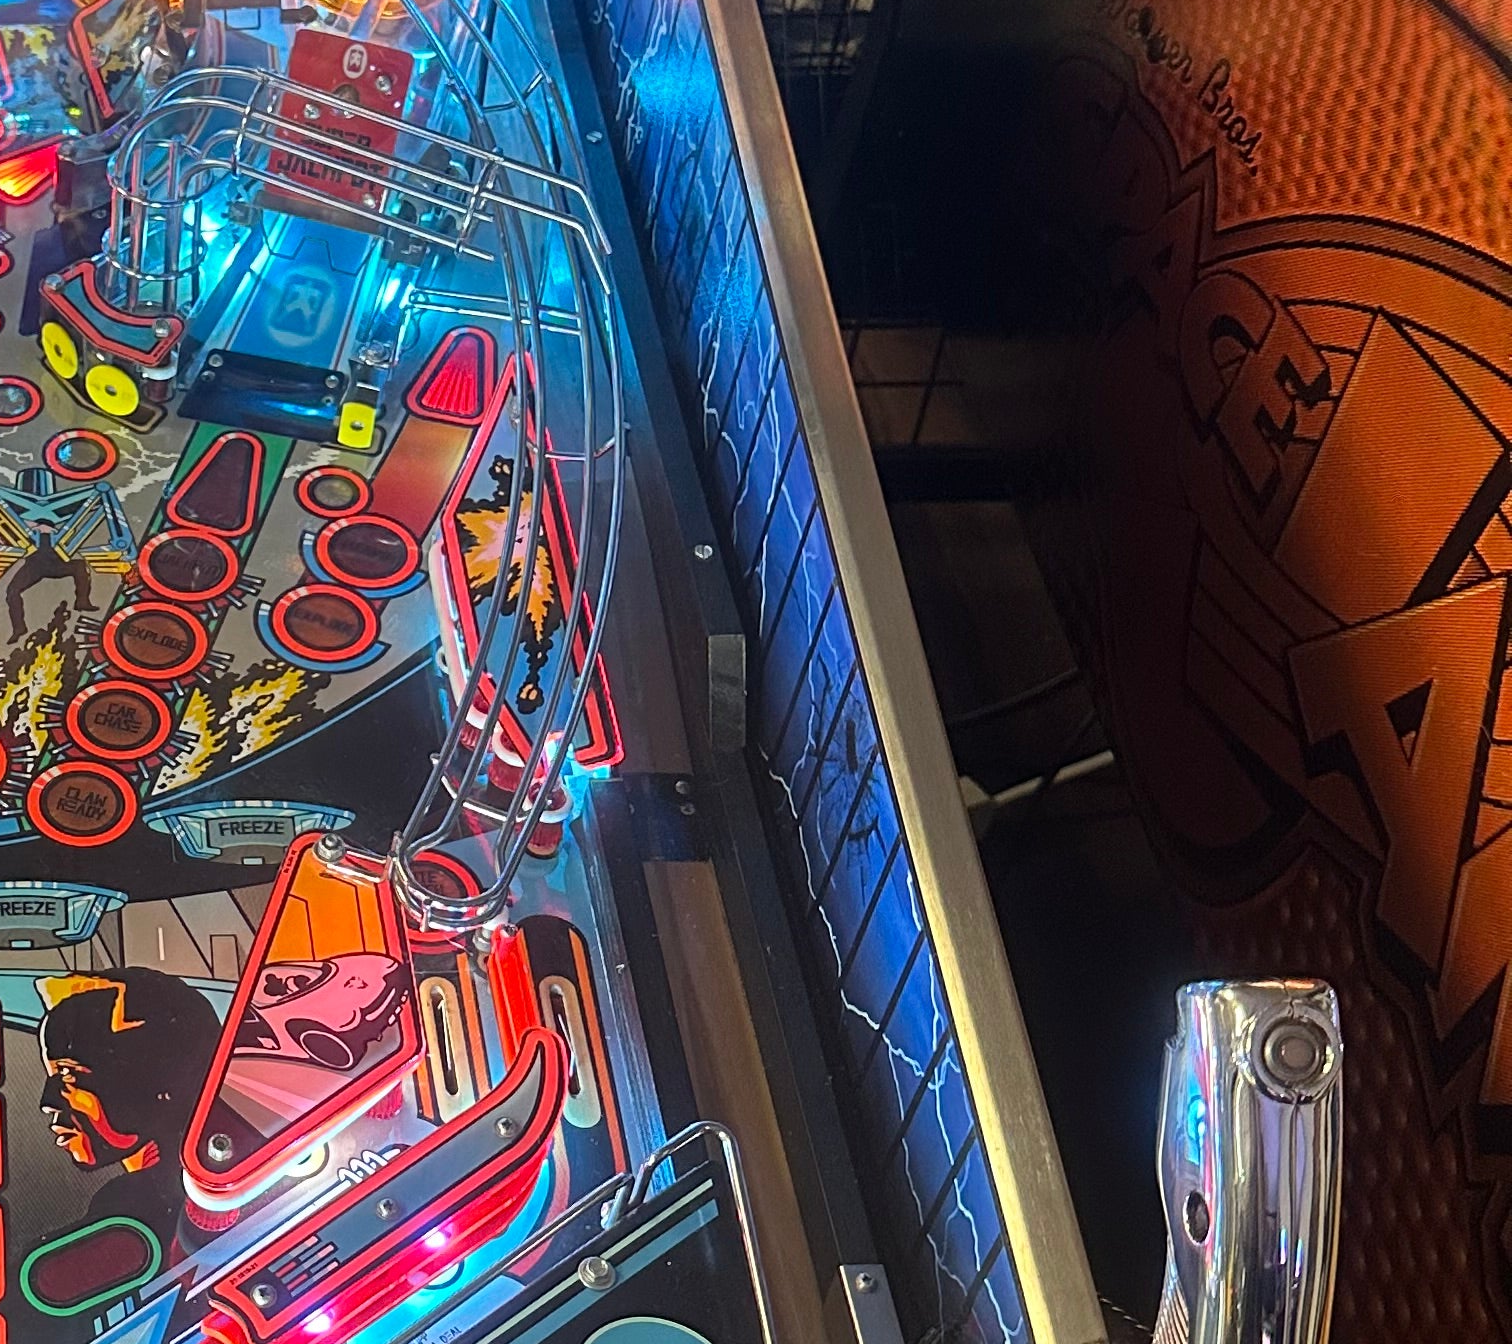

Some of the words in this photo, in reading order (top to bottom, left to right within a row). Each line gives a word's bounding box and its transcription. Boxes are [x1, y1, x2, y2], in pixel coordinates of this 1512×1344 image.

[126, 624, 189, 655] EXPLODE
[105, 701, 137, 719] CAR
[93, 712, 143, 734] CHASE
[64, 786, 107, 808] CLAW
[56, 799, 108, 822] READY
[218, 819, 285, 838] FREEZE
